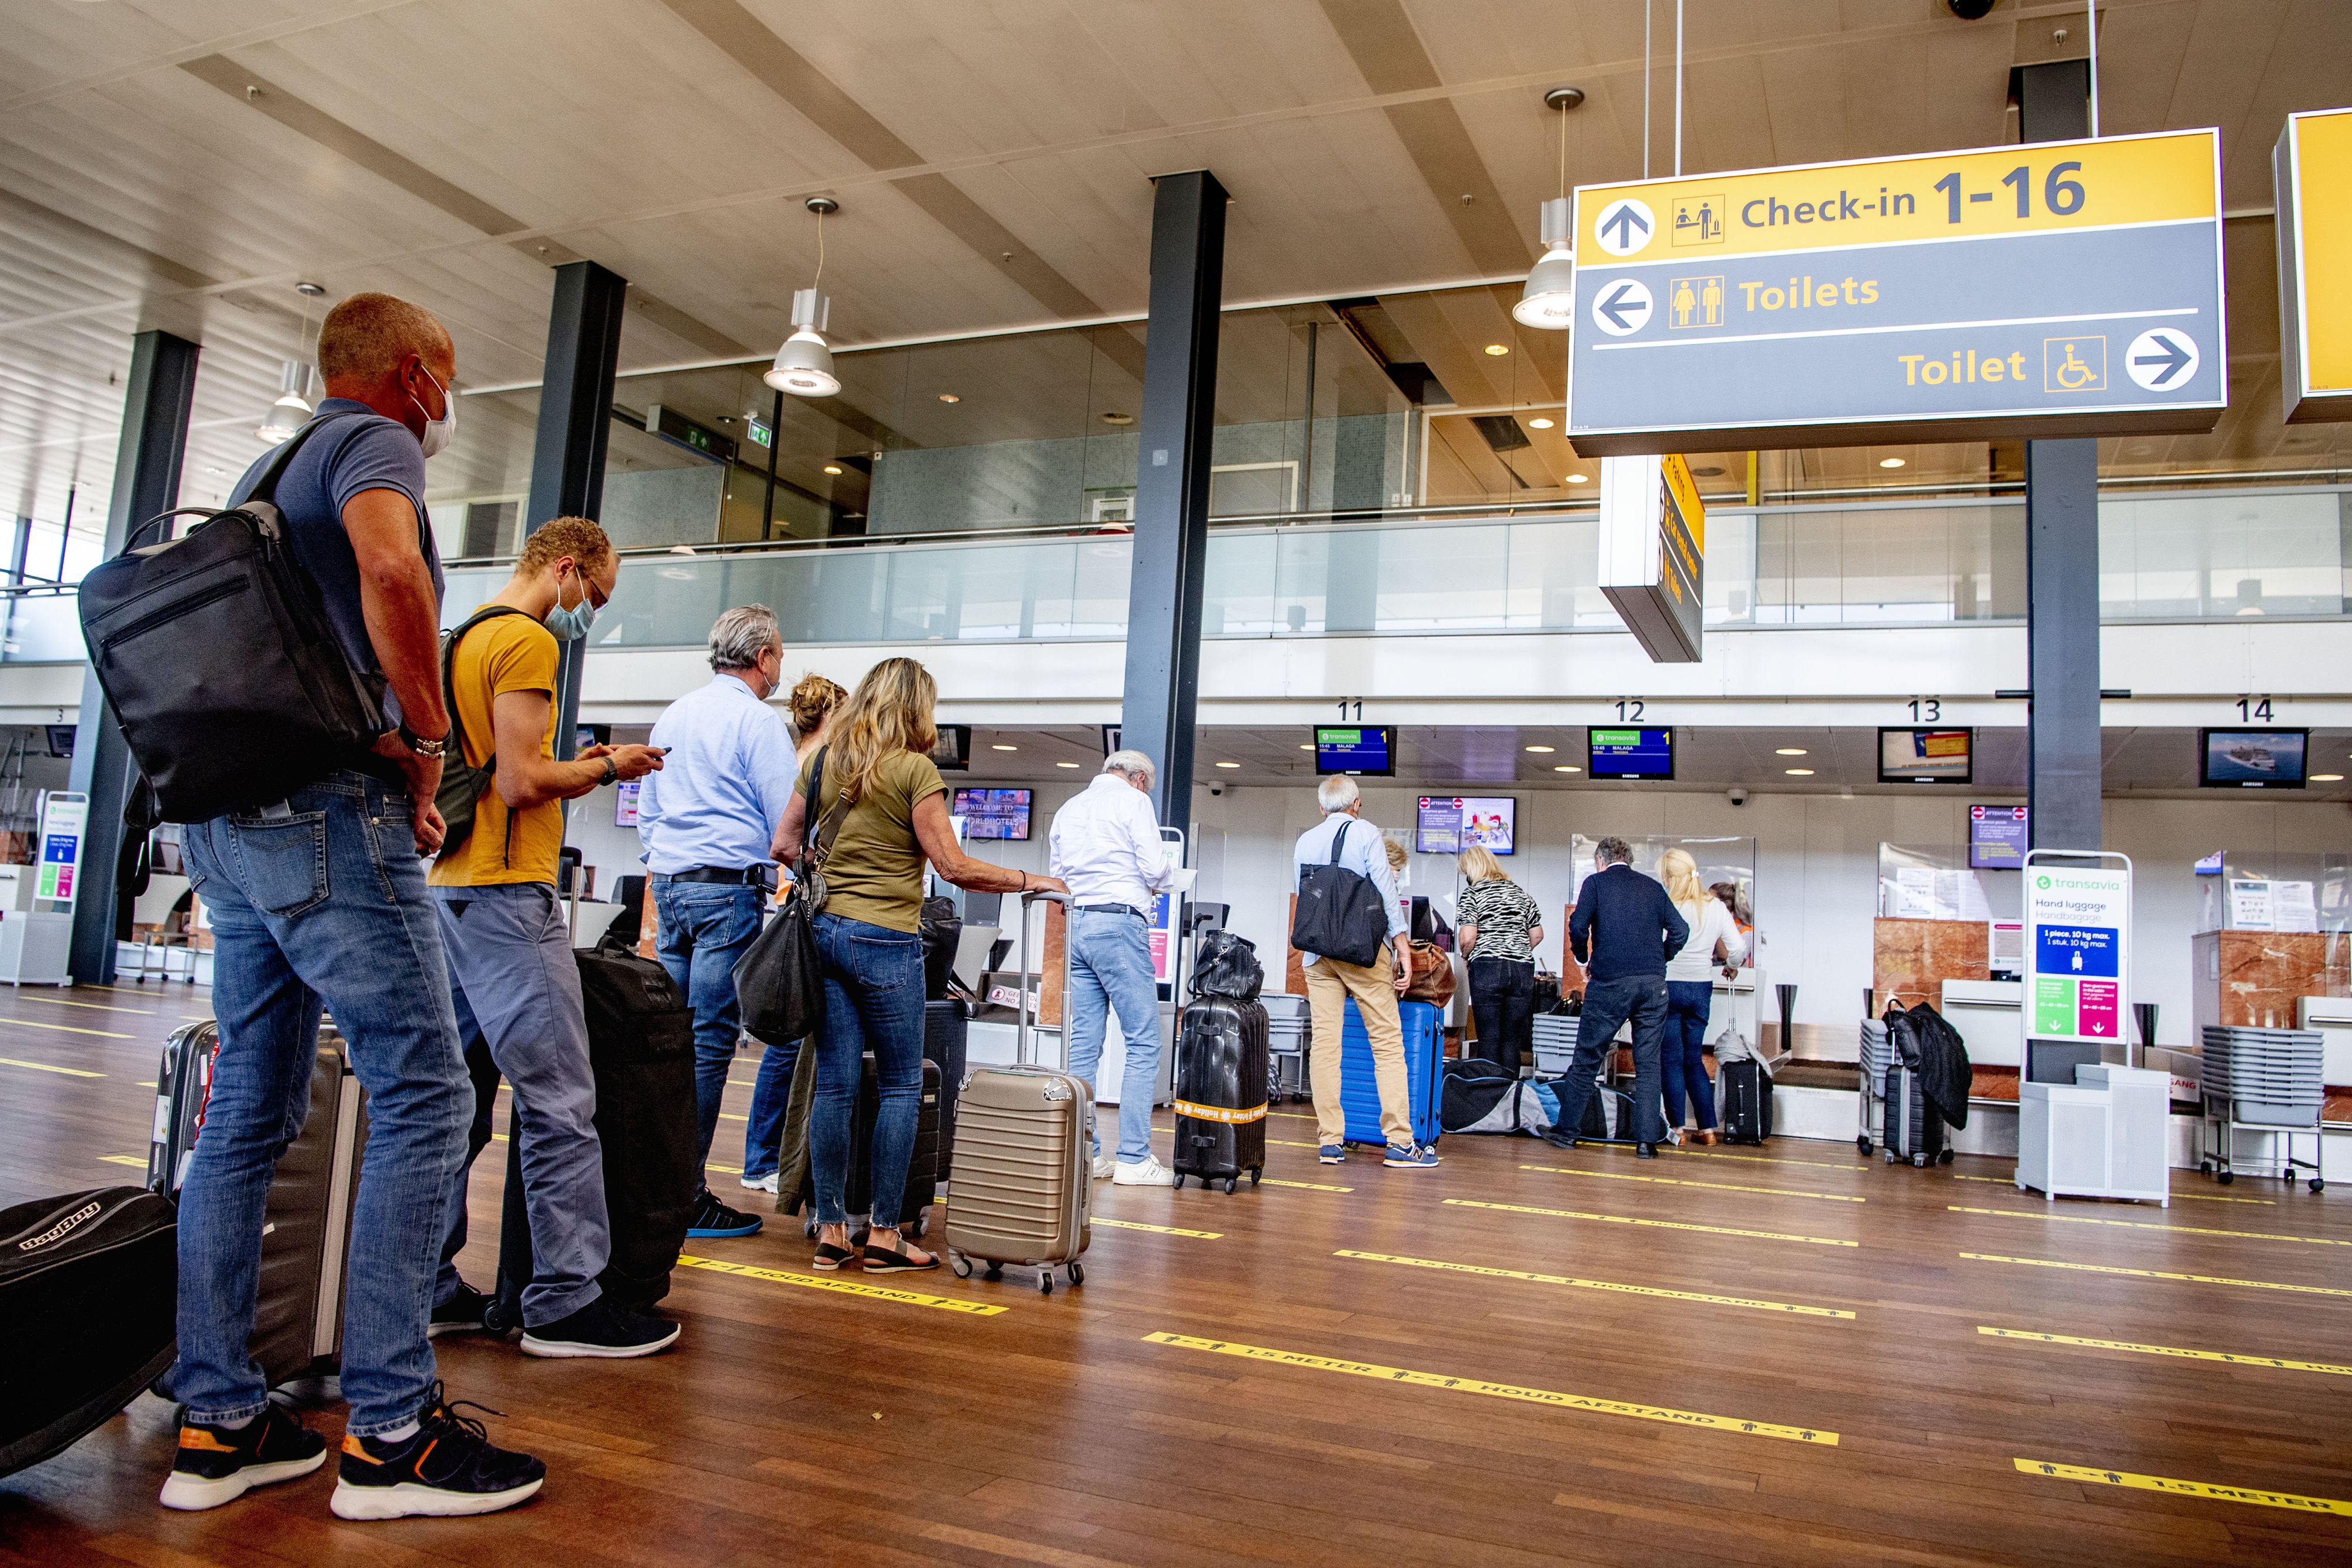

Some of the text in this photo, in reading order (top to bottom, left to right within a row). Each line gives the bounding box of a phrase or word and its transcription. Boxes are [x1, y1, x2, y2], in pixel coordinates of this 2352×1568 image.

[1741, 161, 2086, 228] Check-in 1-16
[1739, 276, 1880, 312] Toilets
[1897, 350, 2027, 386] Toilet
[1673, 456, 1685, 503] Parking
[1676, 536, 1688, 561] rental
[1669, 569, 1682, 606] Toilets
[57, 708, 63, 722] 3
[1338, 701, 1362, 721] 11
[1615, 701, 1645, 722] 12
[1907, 700, 1940, 722] 13
[2236, 698, 2274, 722] 14
[1381, 730, 1387, 743] 1
[1663, 732, 1669, 745] 1
[2055, 878, 2120, 890] transavia
[2036, 899, 2106, 912] Hand luggage
[2036, 911, 2102, 924] Handbagage
[2080, 940, 2089, 949] kg
[2082, 931, 2092, 940] kg
[1194, 1106, 1218, 1119] Holiday
[19, 1201, 101, 1251] BagBoy
[754, 1270, 918, 1300] HOUD AFSTAND
[1592, 1283, 1654, 1292] HOUD
[1661, 1292, 1766, 1306] AFSTAND
[2113, 1343, 2199, 1356] METER
[1245, 1349, 1716, 1424] 1.5 METER HOUD AFSTAND
[2151, 1480, 2334, 1510] 1.5 METER
